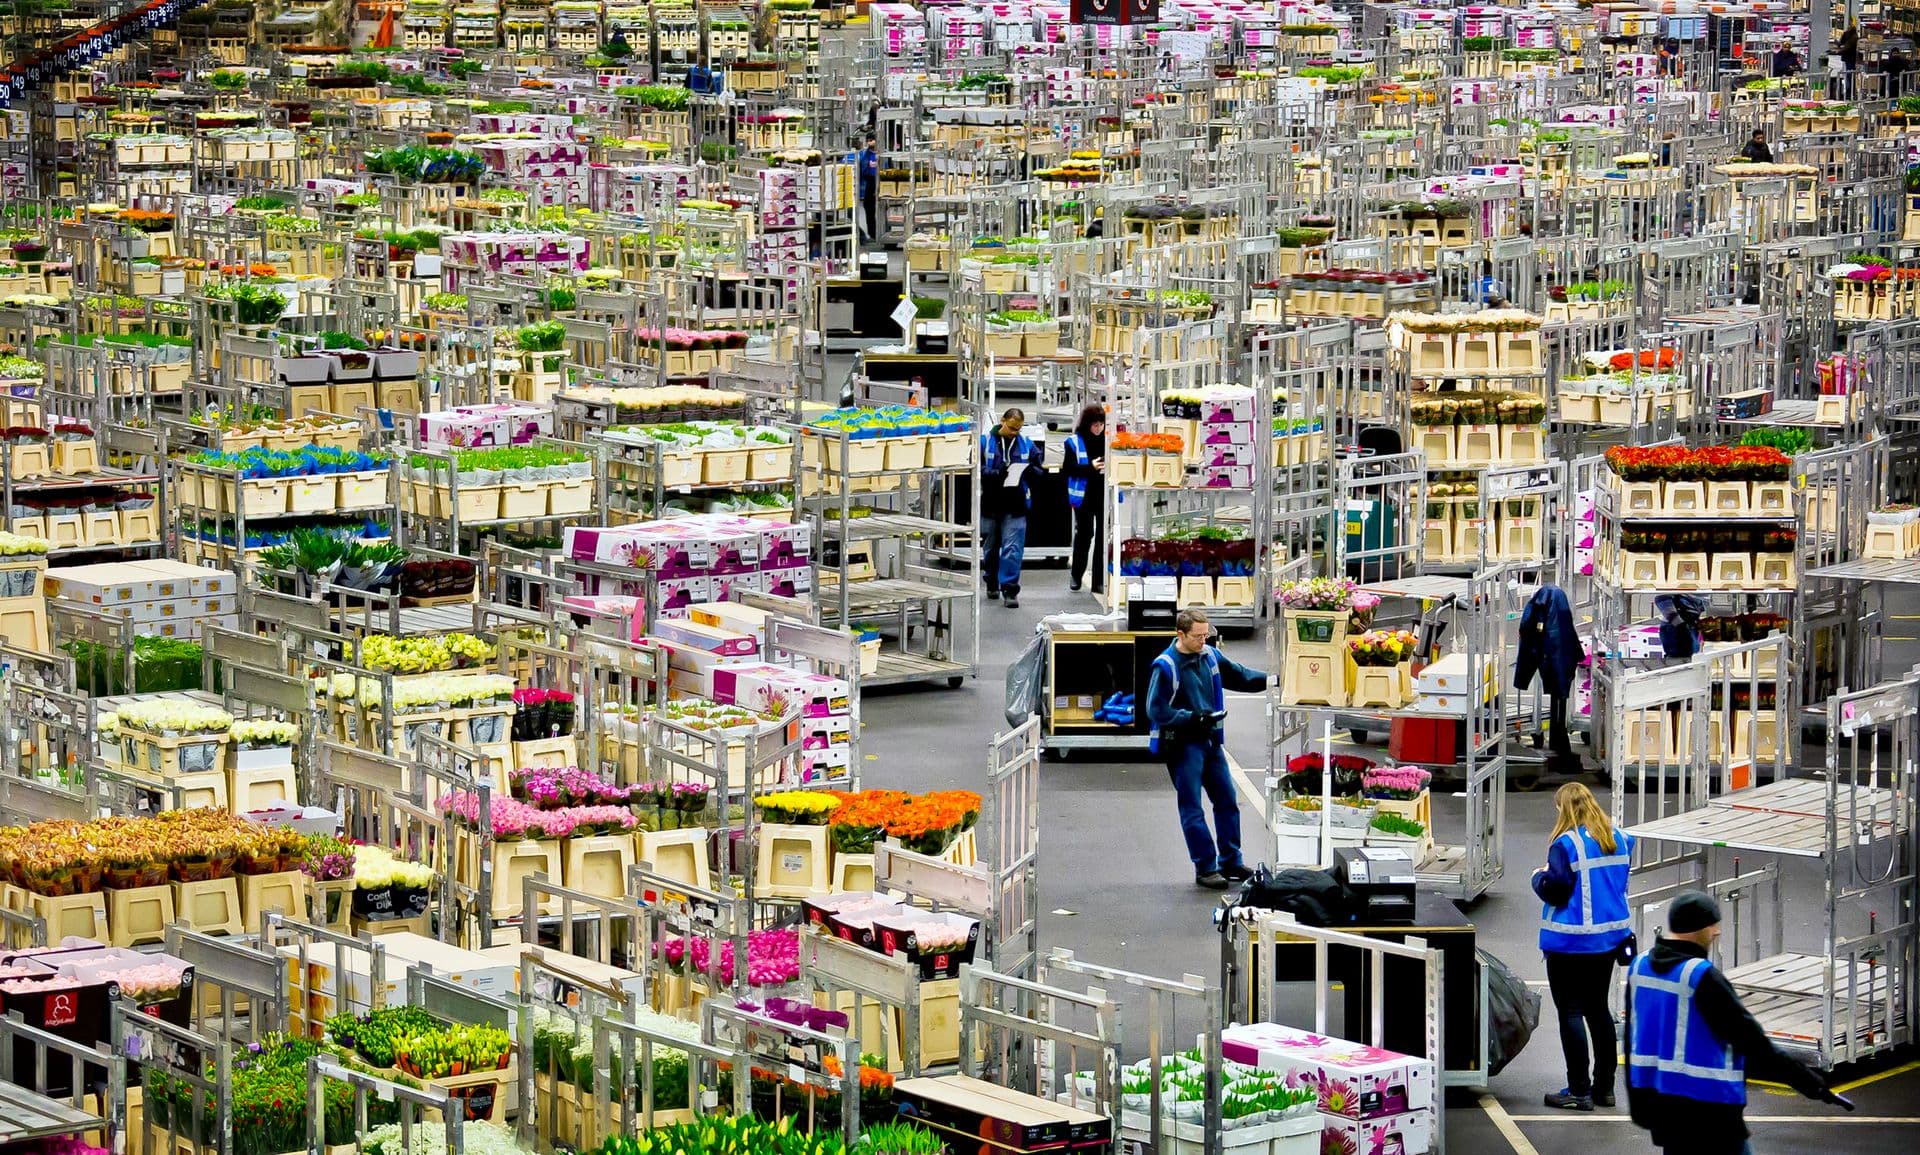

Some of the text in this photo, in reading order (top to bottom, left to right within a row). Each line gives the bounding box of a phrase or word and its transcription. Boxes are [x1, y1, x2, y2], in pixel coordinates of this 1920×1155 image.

[147, 9, 159, 21] 137
[79, 43, 91, 56] 144
[90, 37, 102, 50] 143
[54, 54, 68, 67] 146
[67, 48, 80, 62] 145
[41, 61, 54, 73] 147
[26, 67, 40, 81] 148
[10, 75, 25, 90] 149
[366, 889, 391, 902] Coert
[375, 899, 393, 910] Dijk
